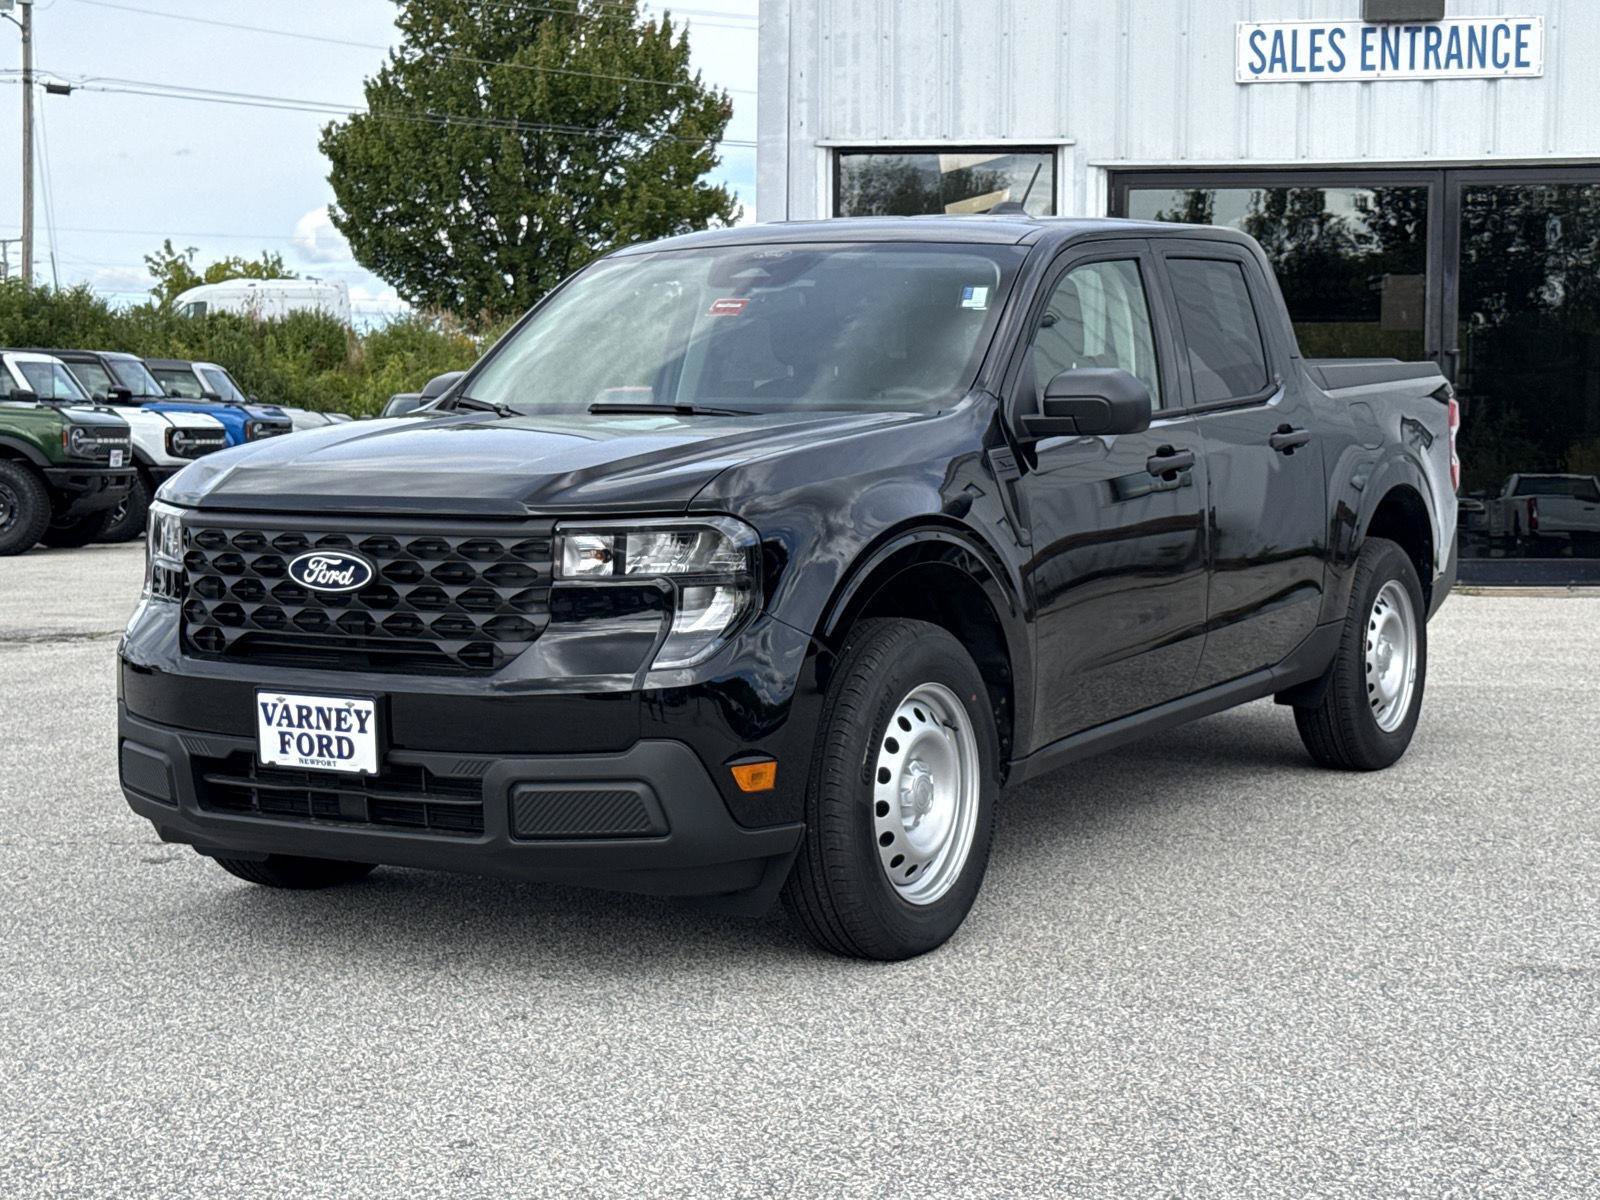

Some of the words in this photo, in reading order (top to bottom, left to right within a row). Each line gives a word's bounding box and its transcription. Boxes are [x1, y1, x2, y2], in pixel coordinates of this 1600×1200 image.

[1248, 27, 1347, 75] SALES
[1360, 23, 1532, 72] ENTRANCE
[303, 556, 355, 586] Ford
[260, 702, 372, 734] VARNEY
[278, 731, 355, 760] FORD
[298, 757, 337, 767] NEWPORT
